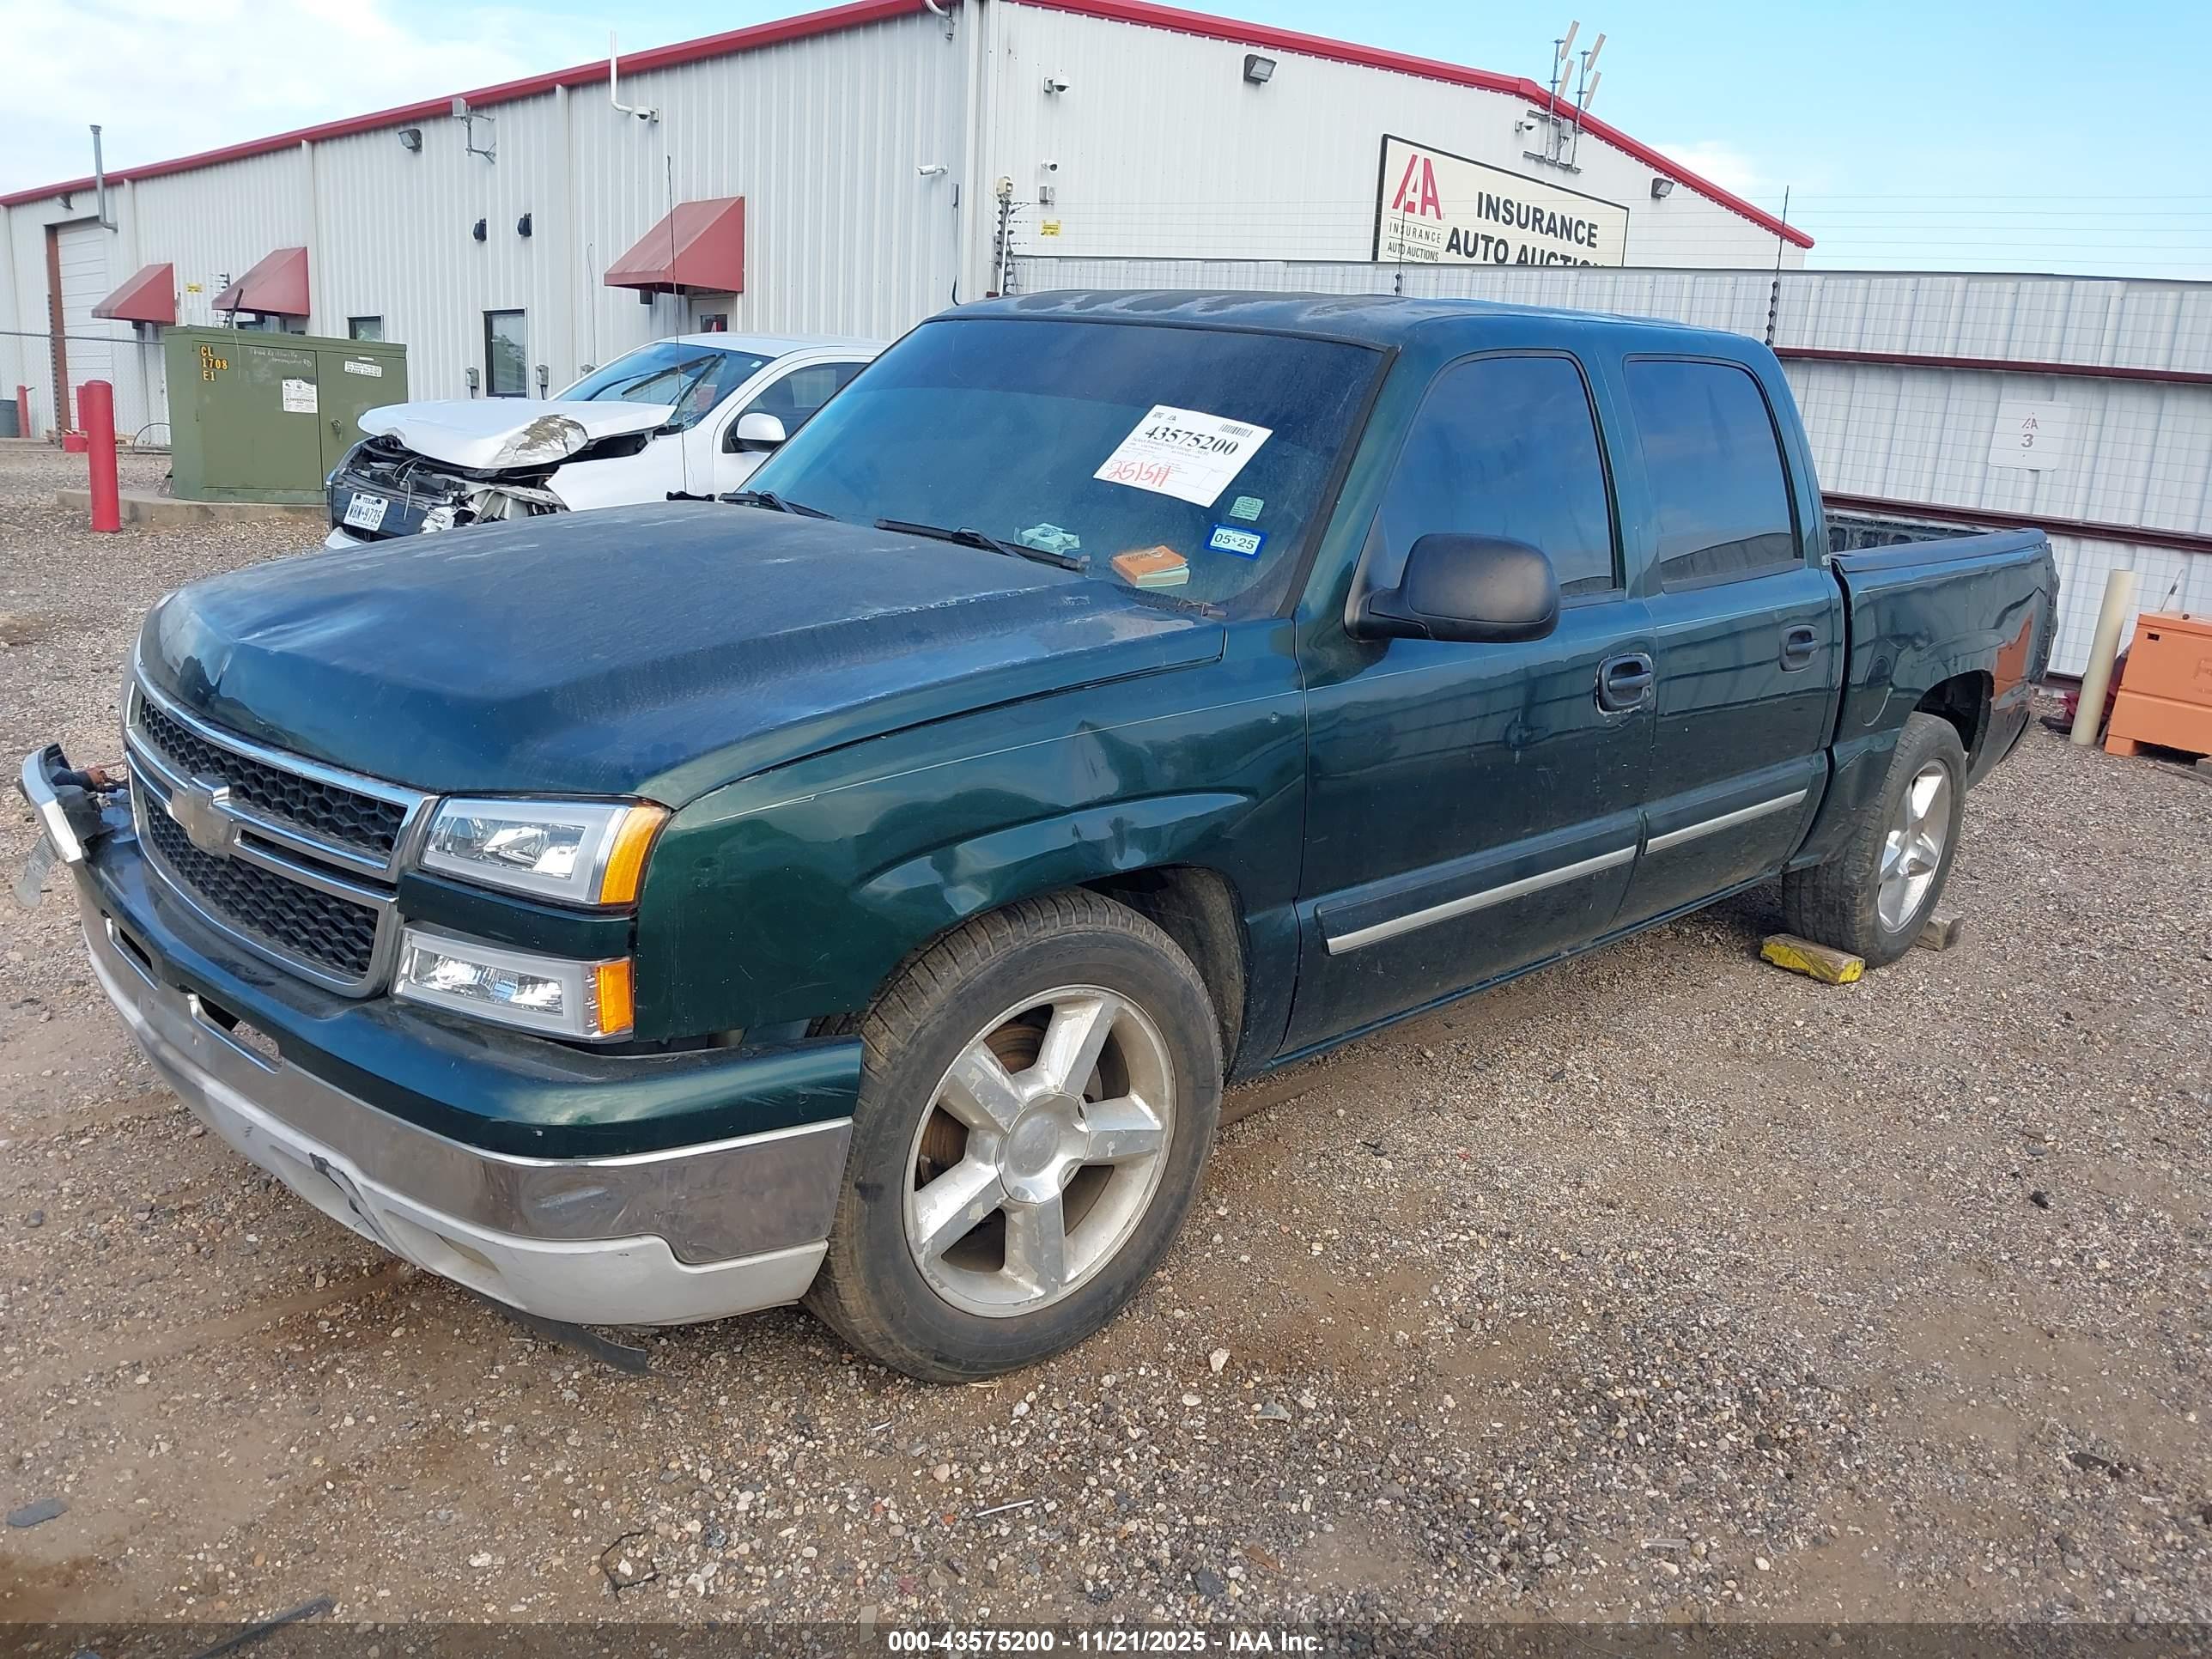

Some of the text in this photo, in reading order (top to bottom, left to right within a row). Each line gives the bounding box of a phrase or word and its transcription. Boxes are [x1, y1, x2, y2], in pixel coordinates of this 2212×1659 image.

[1476, 191, 1599, 248] INSURANCE
[1389, 222, 1441, 244] INSURANCE
[1387, 241, 1440, 263] AUTO AUCTIONS
[1445, 227, 1509, 264] AUTO
[201, 346, 214, 357] CL
[203, 358, 228, 370] 1708
[203, 370, 216, 381] E1
[1145, 425, 1239, 456] 43575200
[2021, 433, 2034, 447] 3
[362, 497, 377, 506] TEXAS
[1214, 533, 1256, 550] 05 25
